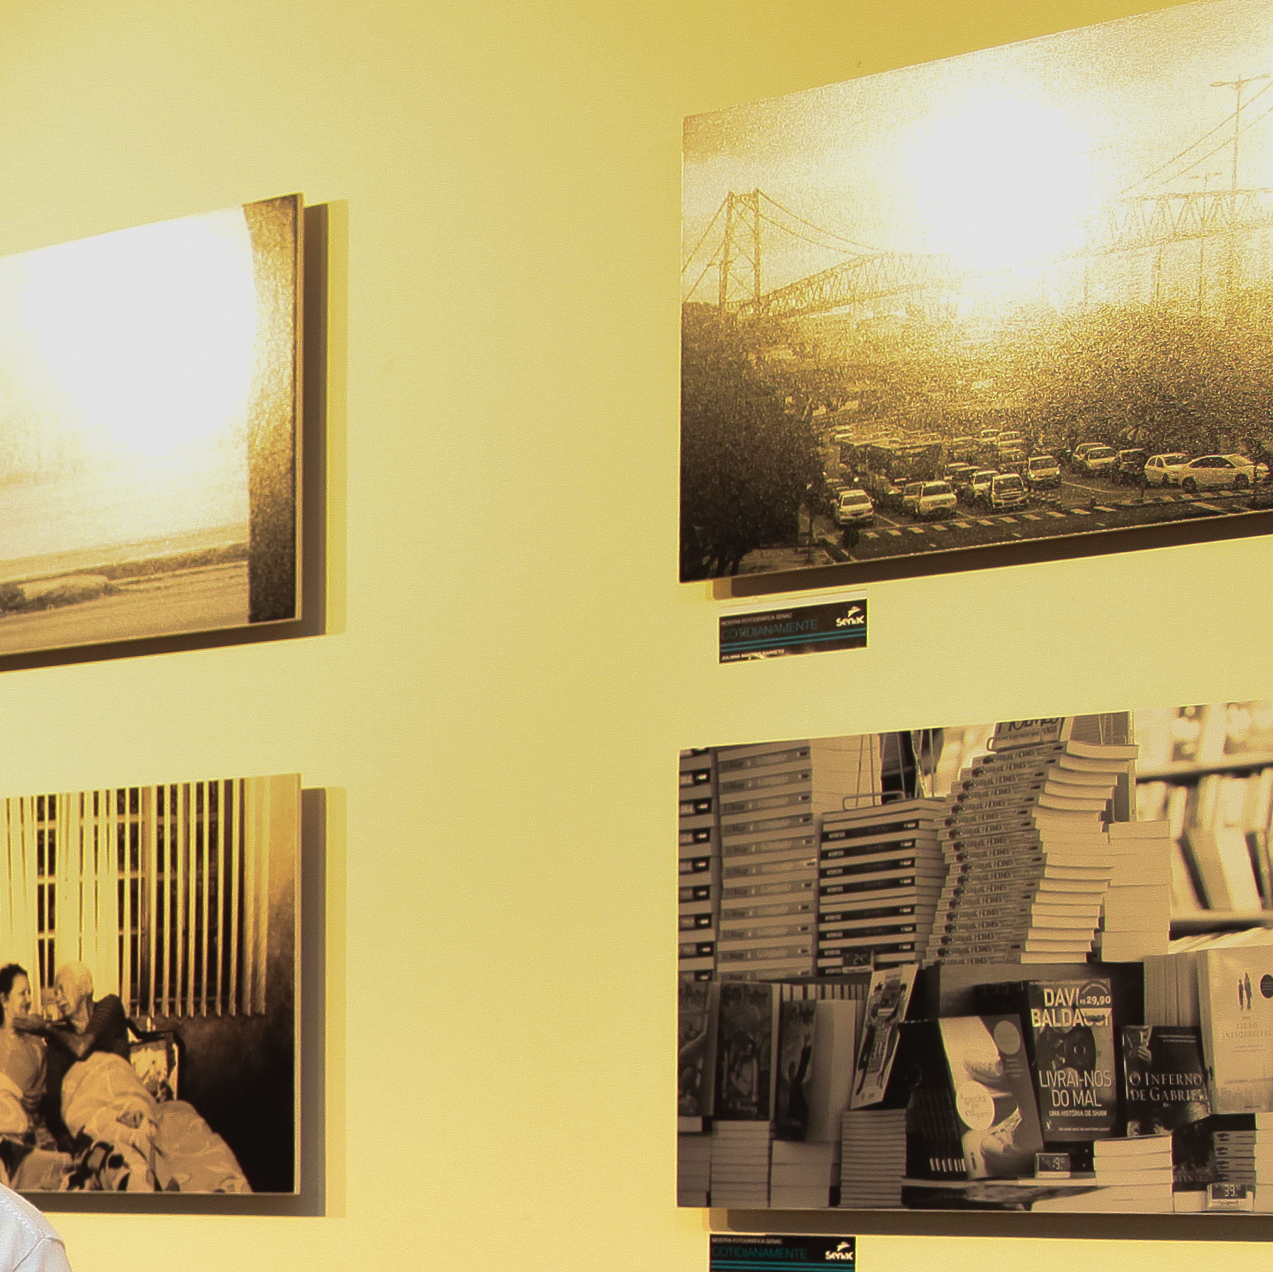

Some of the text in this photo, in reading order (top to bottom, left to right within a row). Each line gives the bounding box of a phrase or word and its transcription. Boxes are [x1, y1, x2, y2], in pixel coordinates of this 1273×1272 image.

[1044, 987, 1082, 1007] DAVI
[1086, 995, 1112, 1007] 29,90
[1039, 1070, 1112, 1088] LIVRAI-NOS
[1129, 1070, 1141, 1086] O
[1051, 1089, 1103, 1107] DO MAL
[1129, 1089, 1147, 1101] DE
[712, 1246, 808, 1260] COTIDIANAMENTE
